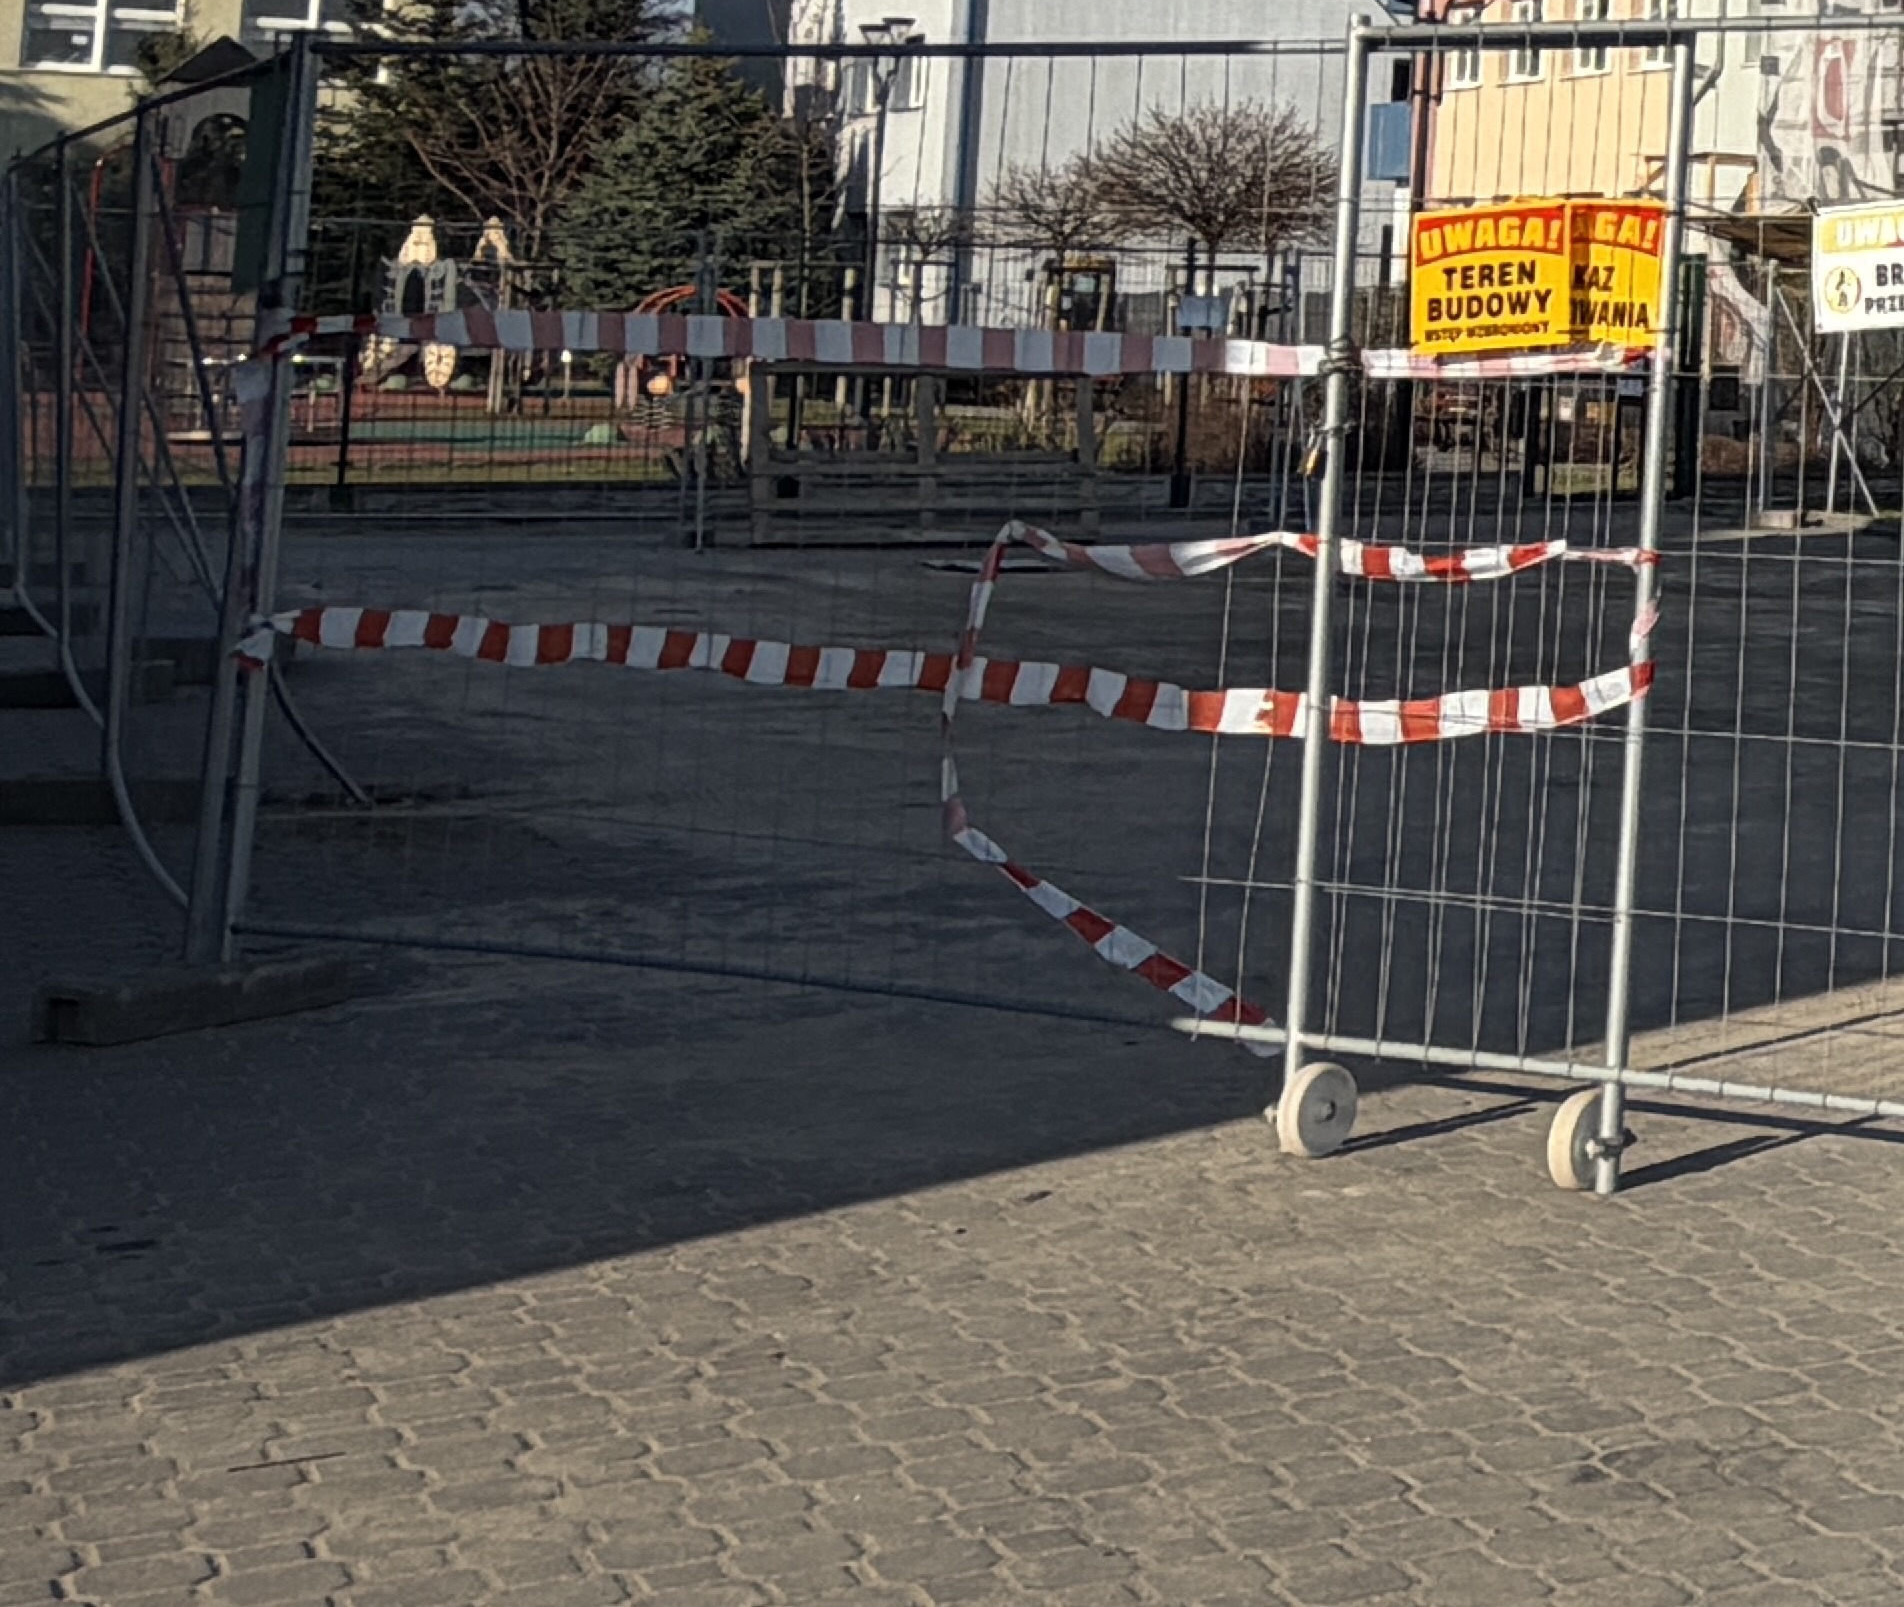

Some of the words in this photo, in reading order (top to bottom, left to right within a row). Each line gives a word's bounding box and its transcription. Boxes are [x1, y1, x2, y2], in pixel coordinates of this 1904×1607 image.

[1419, 215, 1562, 260] UWAGA!
[1573, 209, 1660, 251] AGA!
[1441, 259, 1537, 292] TEREN
[1574, 264, 1616, 292] KAZ
[1426, 288, 1552, 323] BUDOWY
